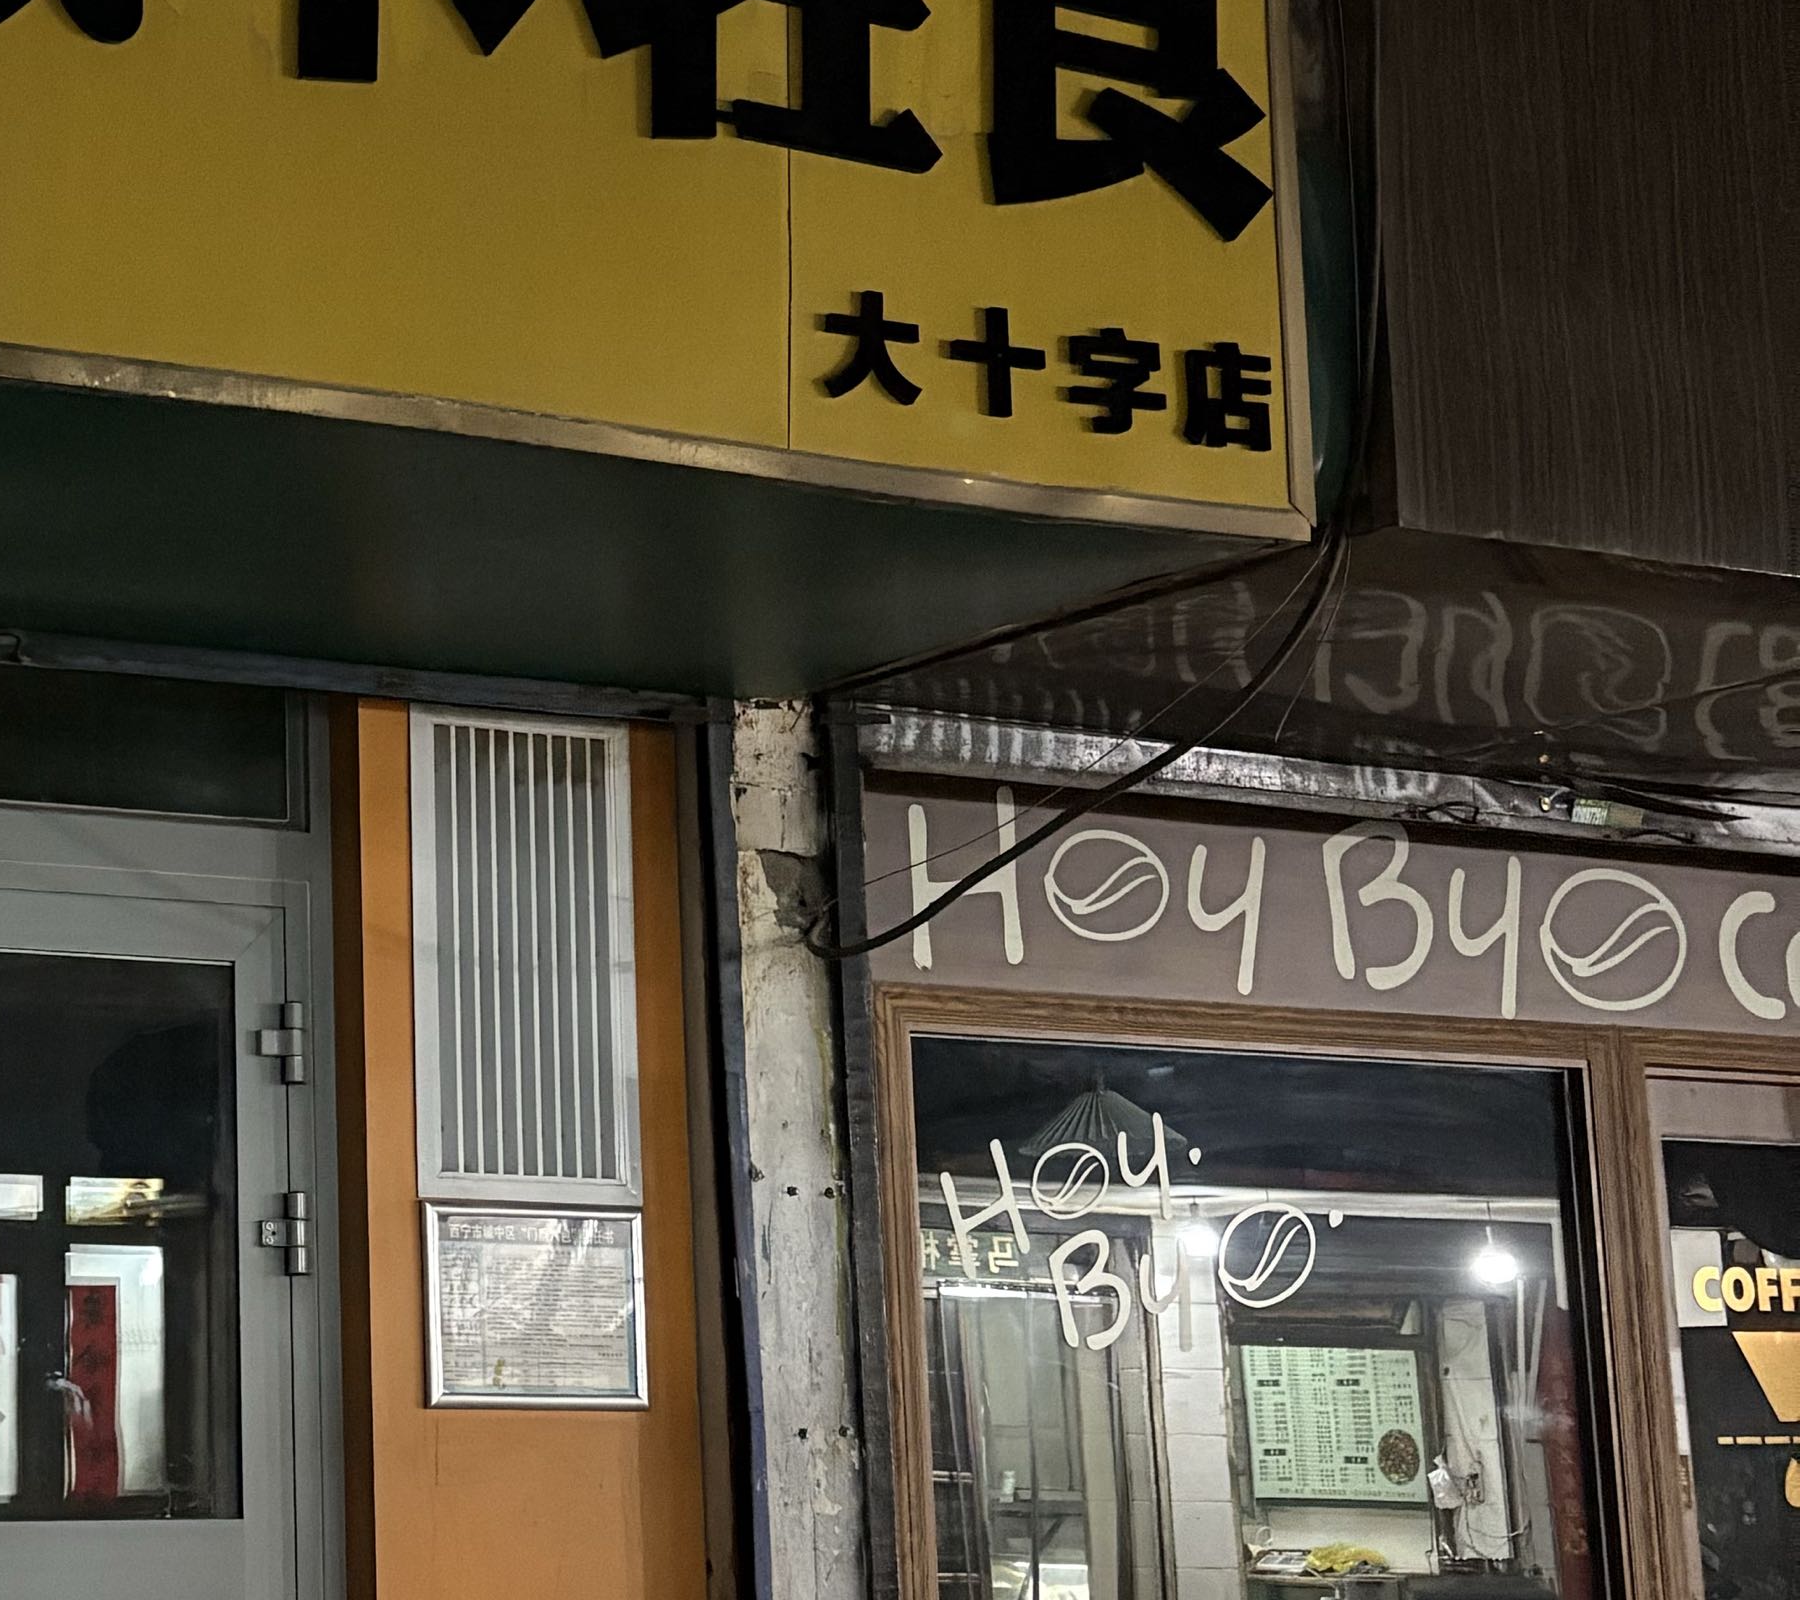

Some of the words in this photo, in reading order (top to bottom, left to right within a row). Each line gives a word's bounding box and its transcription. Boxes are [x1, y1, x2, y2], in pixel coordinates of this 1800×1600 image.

[822, 290, 1272, 452] 大十字店
[1719, 890, 1800, 1020] C
